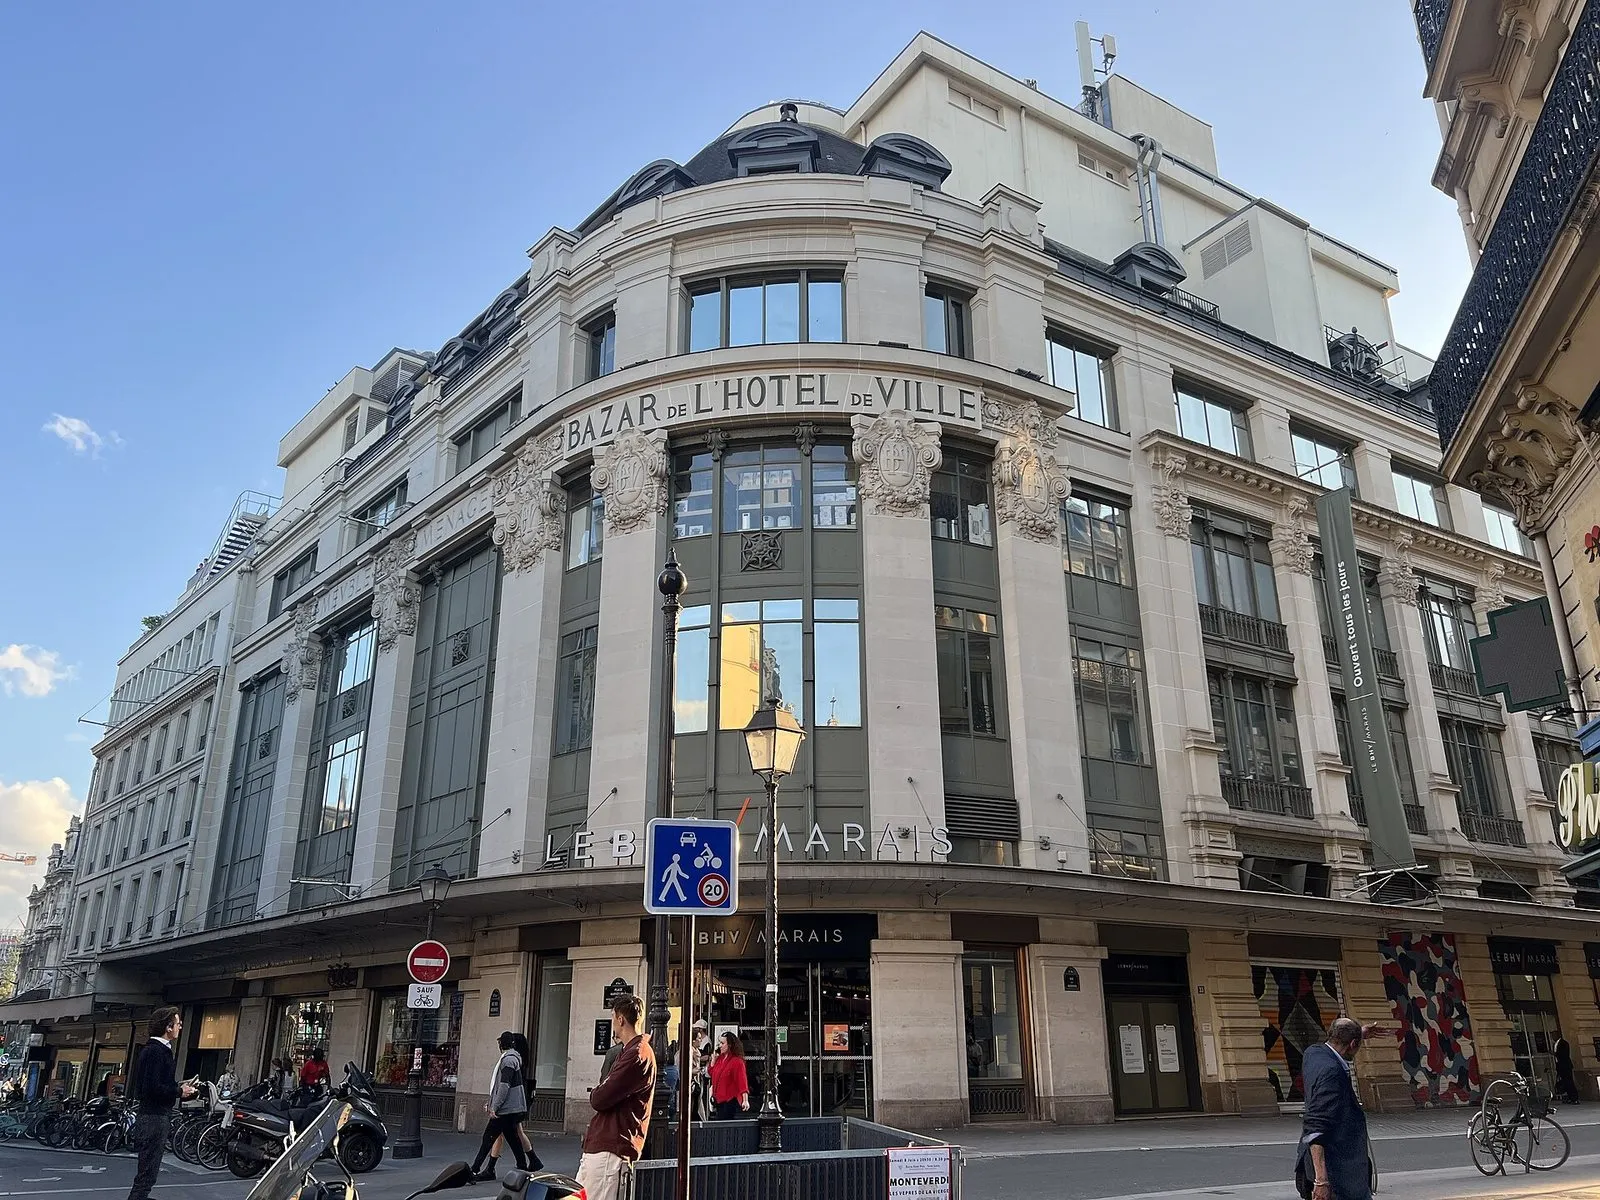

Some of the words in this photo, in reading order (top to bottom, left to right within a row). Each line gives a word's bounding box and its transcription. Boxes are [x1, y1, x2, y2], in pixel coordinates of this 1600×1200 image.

[567, 393, 661, 451] BAZAR
[666, 403, 687, 420] DE
[694, 374, 840, 415] L'HOTEL
[850, 392, 873, 407] DE
[874, 376, 976, 422] VILLE
[1337, 561, 1350, 592] jours
[1342, 593, 1351, 612] les
[1345, 613, 1356, 641] tous
[1348, 642, 1363, 688] Ouvert
[1370, 762, 1378, 773] LE
[546, 831, 594, 862] LE
[753, 822, 953, 856] MARAIS
[704, 884, 722, 897] 20
[698, 930, 740, 945] BHV
[1491, 952, 1501, 962] LE
[1503, 953, 1521, 963] BHV
[889, 1177, 949, 1187] MONTEVERDI
